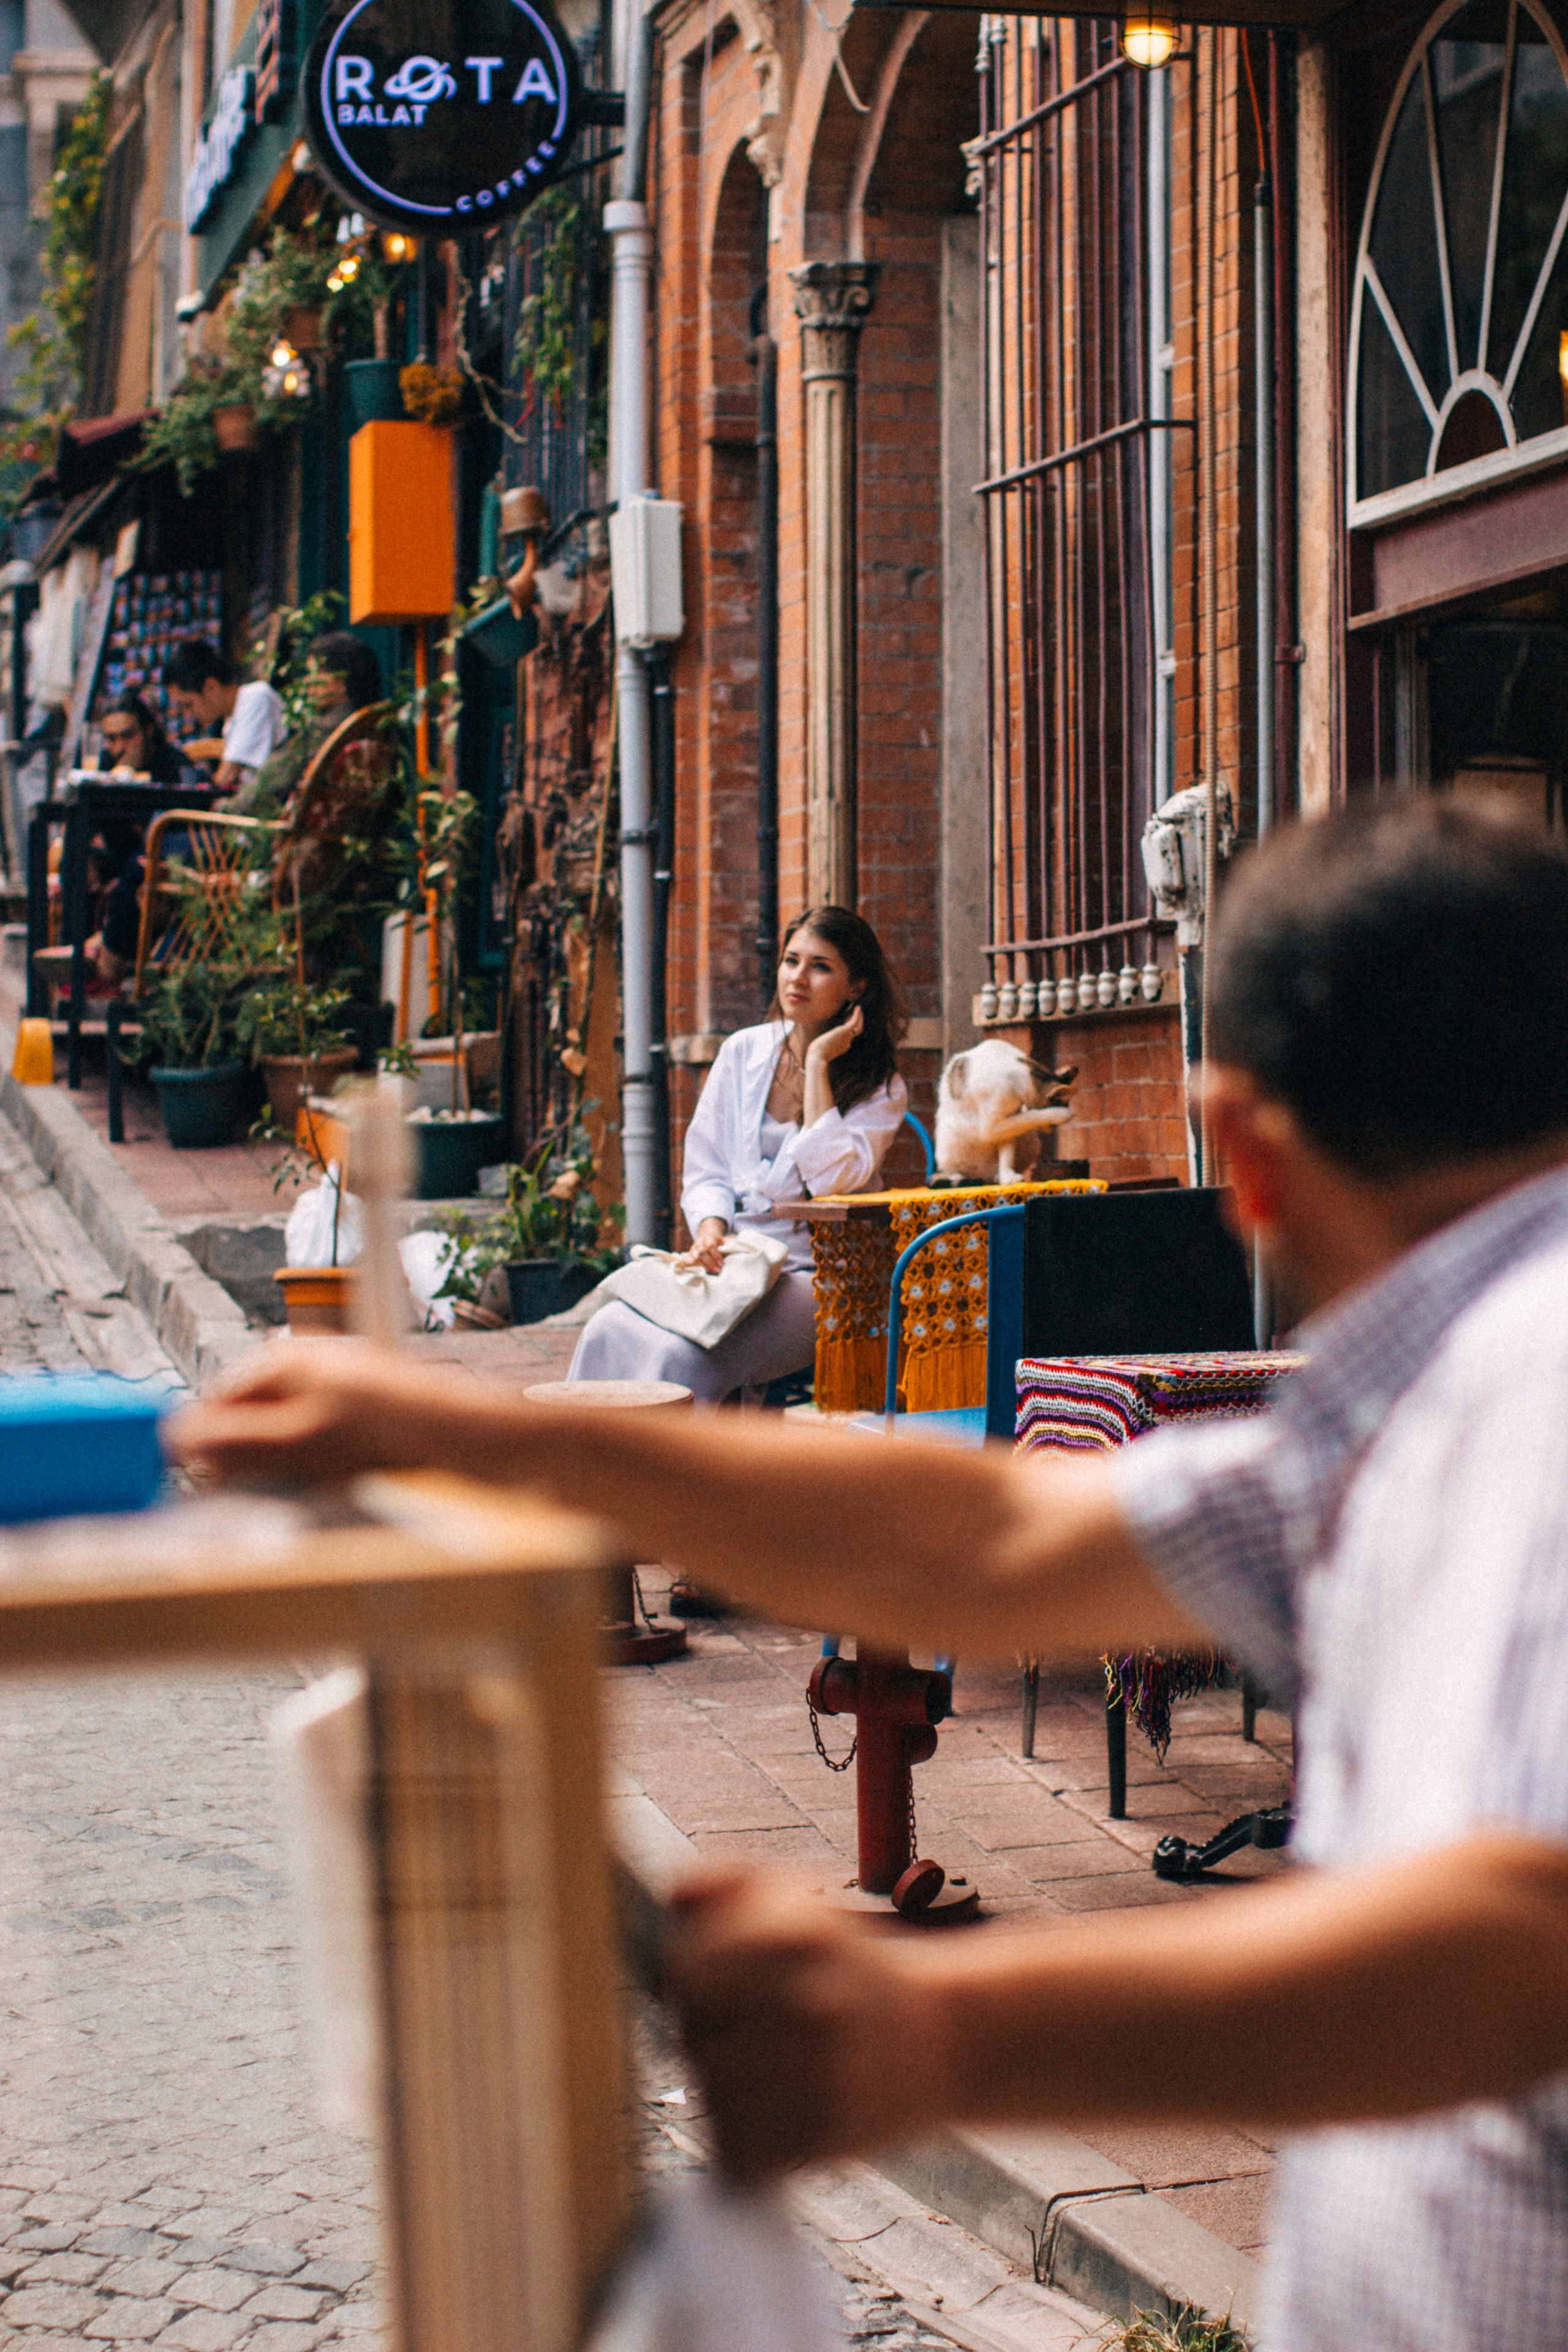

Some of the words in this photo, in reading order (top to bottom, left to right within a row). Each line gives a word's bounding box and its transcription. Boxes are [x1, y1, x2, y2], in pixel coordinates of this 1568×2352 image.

[335, 55, 557, 104] ROTA
[337, 104, 428, 126] BALAT
[456, 140, 556, 213] COFFEE
